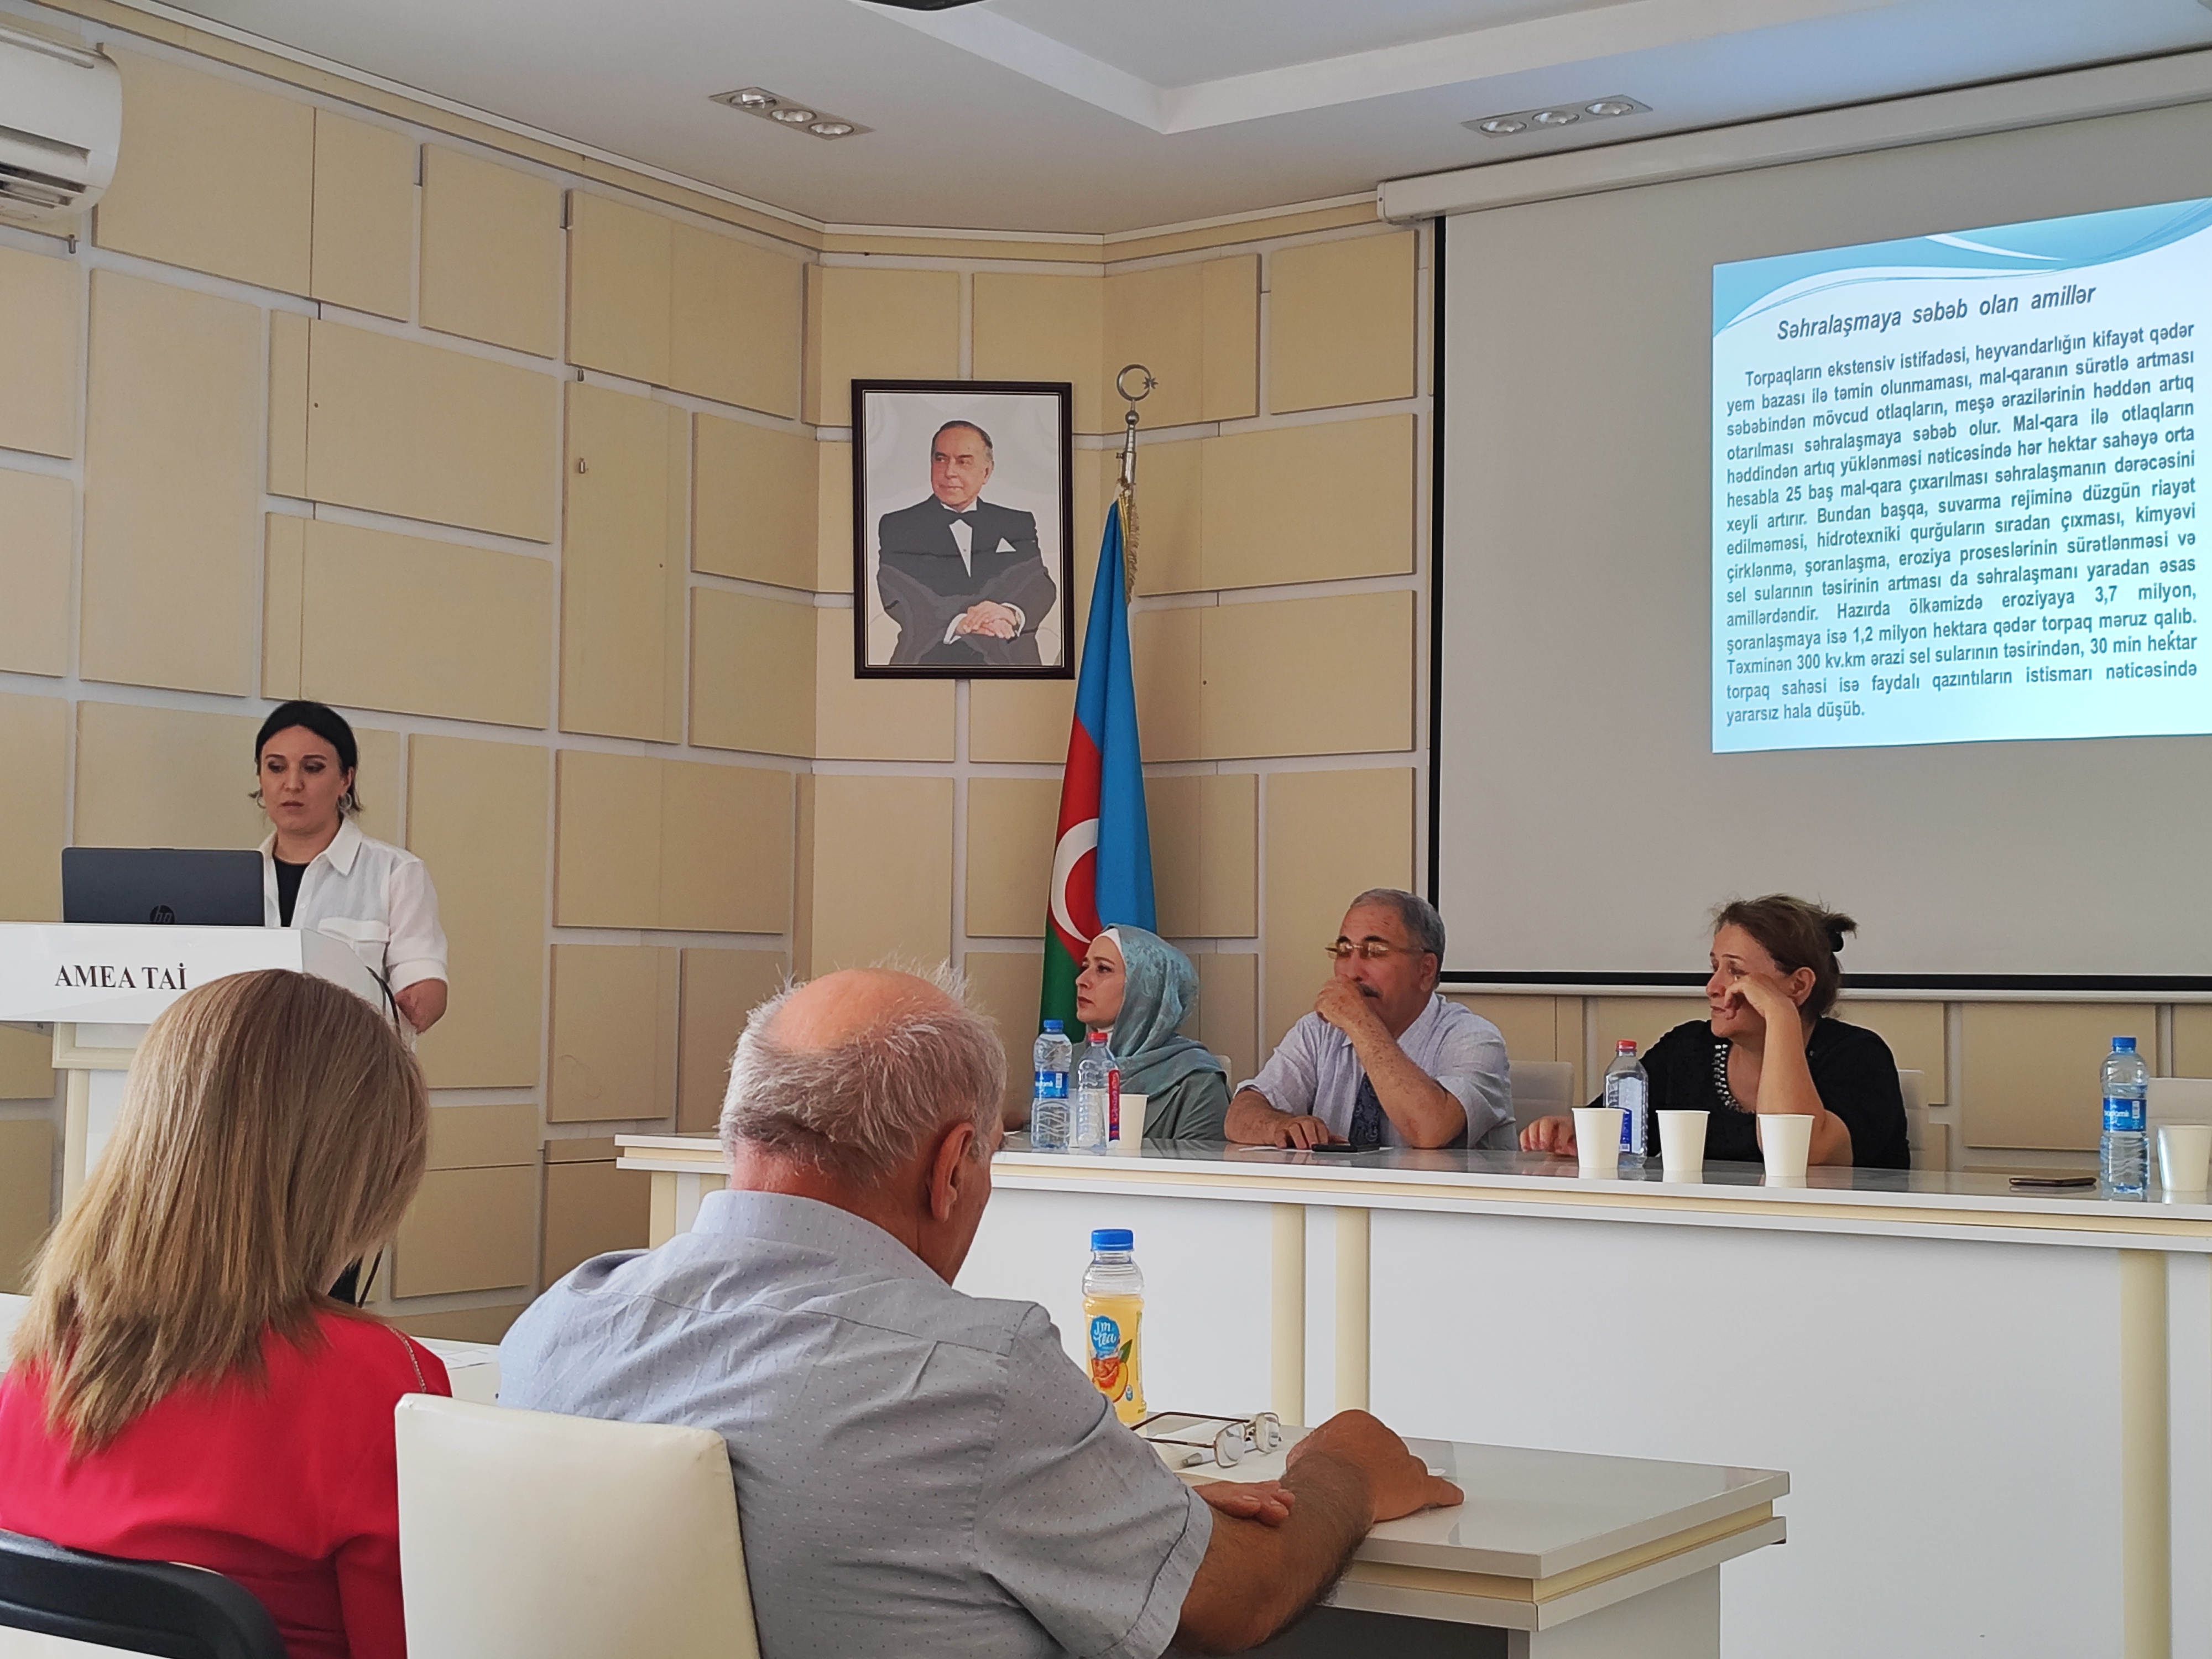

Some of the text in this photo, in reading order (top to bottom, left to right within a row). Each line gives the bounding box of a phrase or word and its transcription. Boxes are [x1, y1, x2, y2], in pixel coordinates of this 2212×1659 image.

[1777, 284, 2096, 340] Səhralaşmaya səbəb olan amillər
[1745, 322, 2194, 388] Torpaqların ekstensiv istifadəsi, heyvandarlığın kifayət qədər
[1727, 351, 2193, 416] yem bazası ilə təmin olunmaması, mal-qaranın sürətlə artması
[1727, 375, 2193, 436] səbəbindən mövcud otlaqların, meşə ərazilərinin həddən artıq
[1728, 401, 2194, 460] otarılması səhralaşmaya səbəb olur. Mal-qara ilə otlaqların
[1728, 426, 2194, 484] həddindən artıq yüklənməsi nəticəsində hər hektar sahəyə orta
[1728, 450, 2194, 507] hesabla 25 baş mal-qara çıxarılması səhralaşmanın dərəcəsini
[1727, 477, 2195, 535] xeyli artırır. Bundan başqa, suvarma rejiminə düzgün riayət
[1727, 502, 2195, 555] edilməməsi, hidrotexniki qurğuların sıradan çıxması, kimyəvi
[1727, 531, 2195, 583] çirklənmə, şoranlaşma, eroziya proseslərinin sürətlənməsi və
[1727, 559, 2195, 603] sel sularının təsirinin artması da səhralaşmanı yaradan əsas
[1727, 583, 2196, 627] amillərdəndir. Hazırda ölkəmizdə eroziyaya 3,7 milyon,
[1727, 607, 2196, 655] şoranlaşmaya isə 1,2 milyon hektara qədər torpaq məruz qalıb.
[1727, 657, 1792, 674] Təxminən
[1797, 654, 1820, 670] 300
[1825, 651, 1865, 668] kv.km
[1871, 648, 1904, 666] ərazi
[1910, 647, 1930, 664] sel
[1936, 645, 1998, 662] sularının
[2004, 639, 2084, 658] təsirindən,
[2090, 638, 2107, 654] 30
[2114, 636, 2141, 653] min
[1727, 660, 2197, 702] torpaq sahəsi isə faydalı qazıntıların istismarı nəticəsində
[1727, 701, 1864, 727] yararsız hala düşüb.
[55, 962, 187, 990] AMEA TAİ
